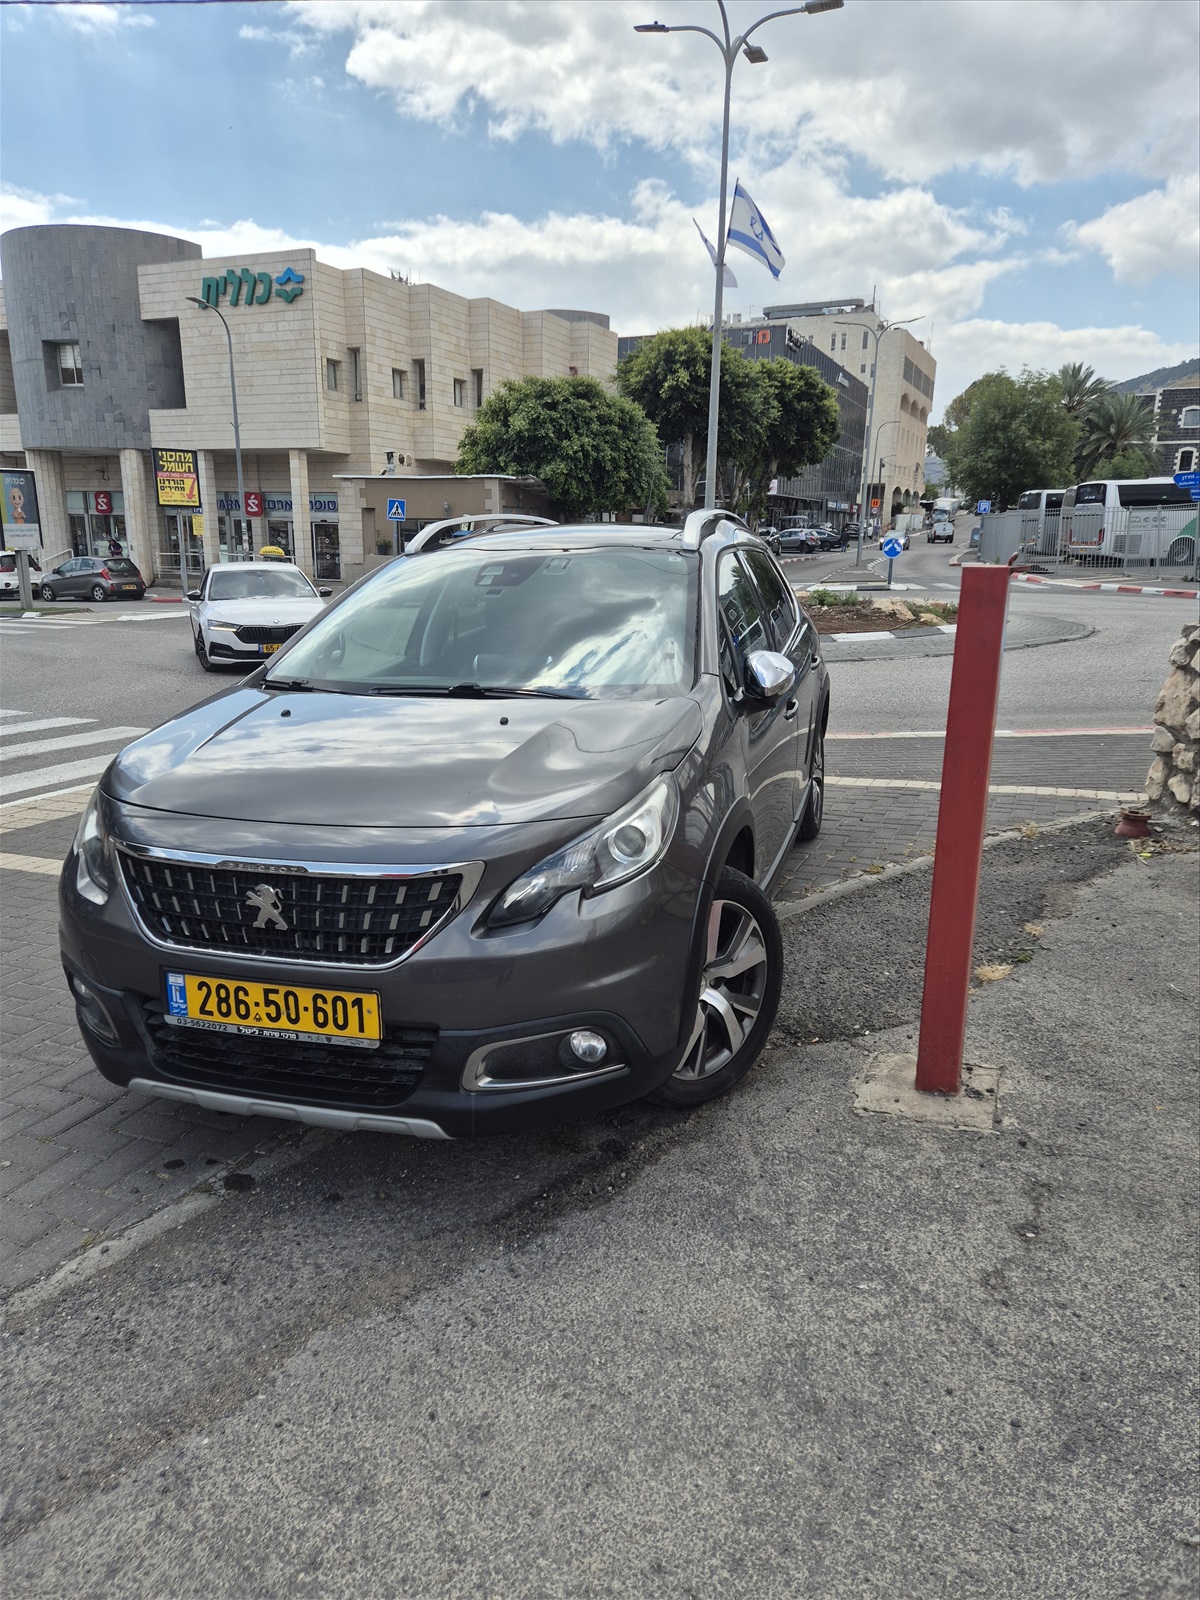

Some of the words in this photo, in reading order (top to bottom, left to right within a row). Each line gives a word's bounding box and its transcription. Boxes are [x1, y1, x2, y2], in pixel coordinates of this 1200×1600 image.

[198, 268, 273, 310] כללית
[158, 451, 193, 462] מחסני
[160, 461, 194, 472] חשמל
[267, 500, 293, 510] ארם
[177, 1017, 229, 1032] 03-5622072
